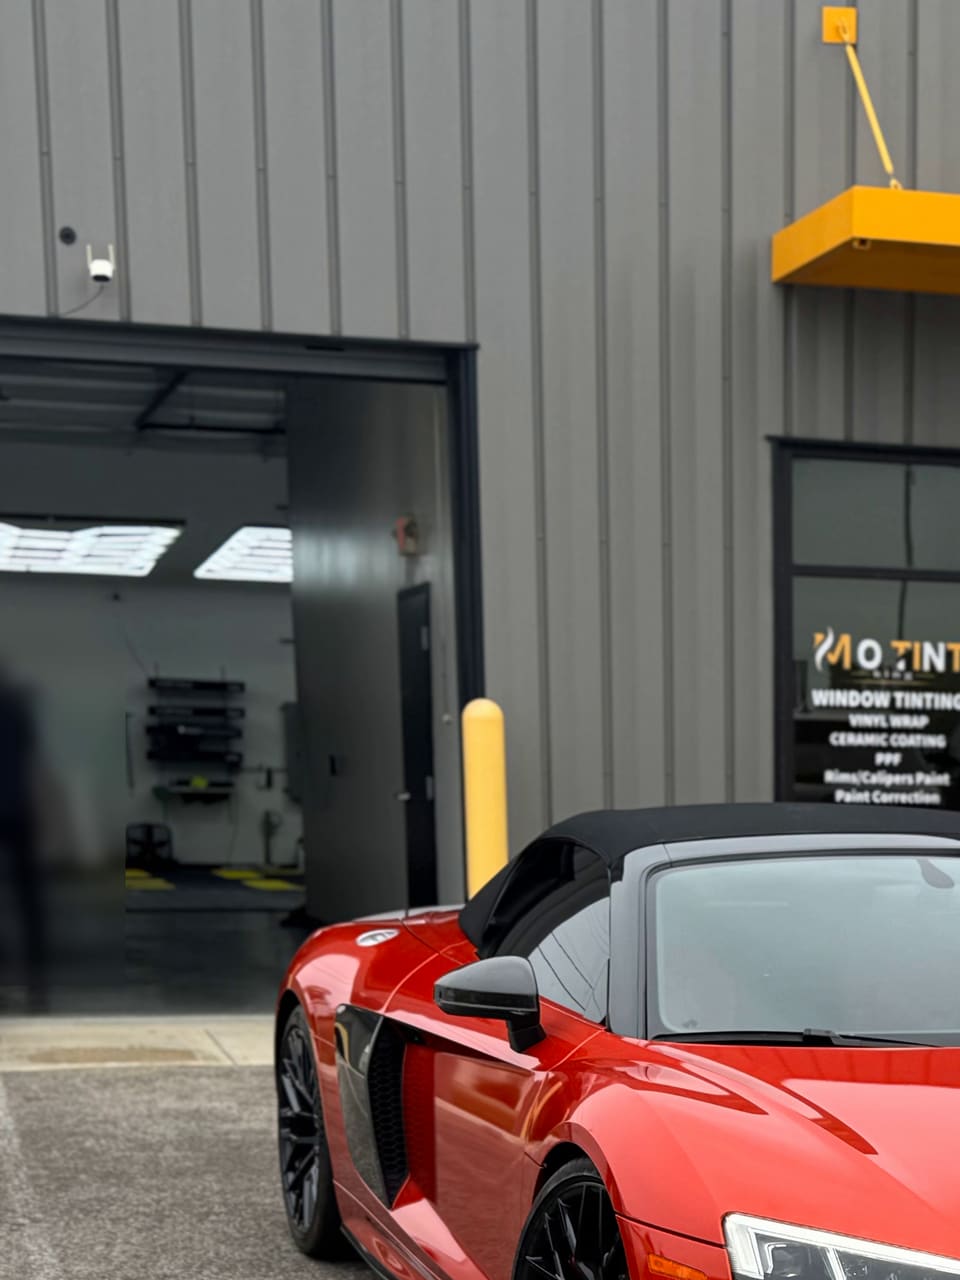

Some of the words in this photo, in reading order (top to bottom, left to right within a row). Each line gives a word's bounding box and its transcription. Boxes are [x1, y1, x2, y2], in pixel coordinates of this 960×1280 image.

[811, 689, 890, 707] WINDOW
[848, 713, 888, 728] VINYL
[889, 715, 929, 729] WRAP
[830, 732, 888, 747] CERAMIC
[890, 733, 946, 748] COATING
[874, 752, 902, 766] PPF
[824, 769, 914, 787] Rims/Calipers
[915, 771, 950, 786] Paint
[835, 789, 870, 803] Paint
[871, 789, 941, 804] Correction
